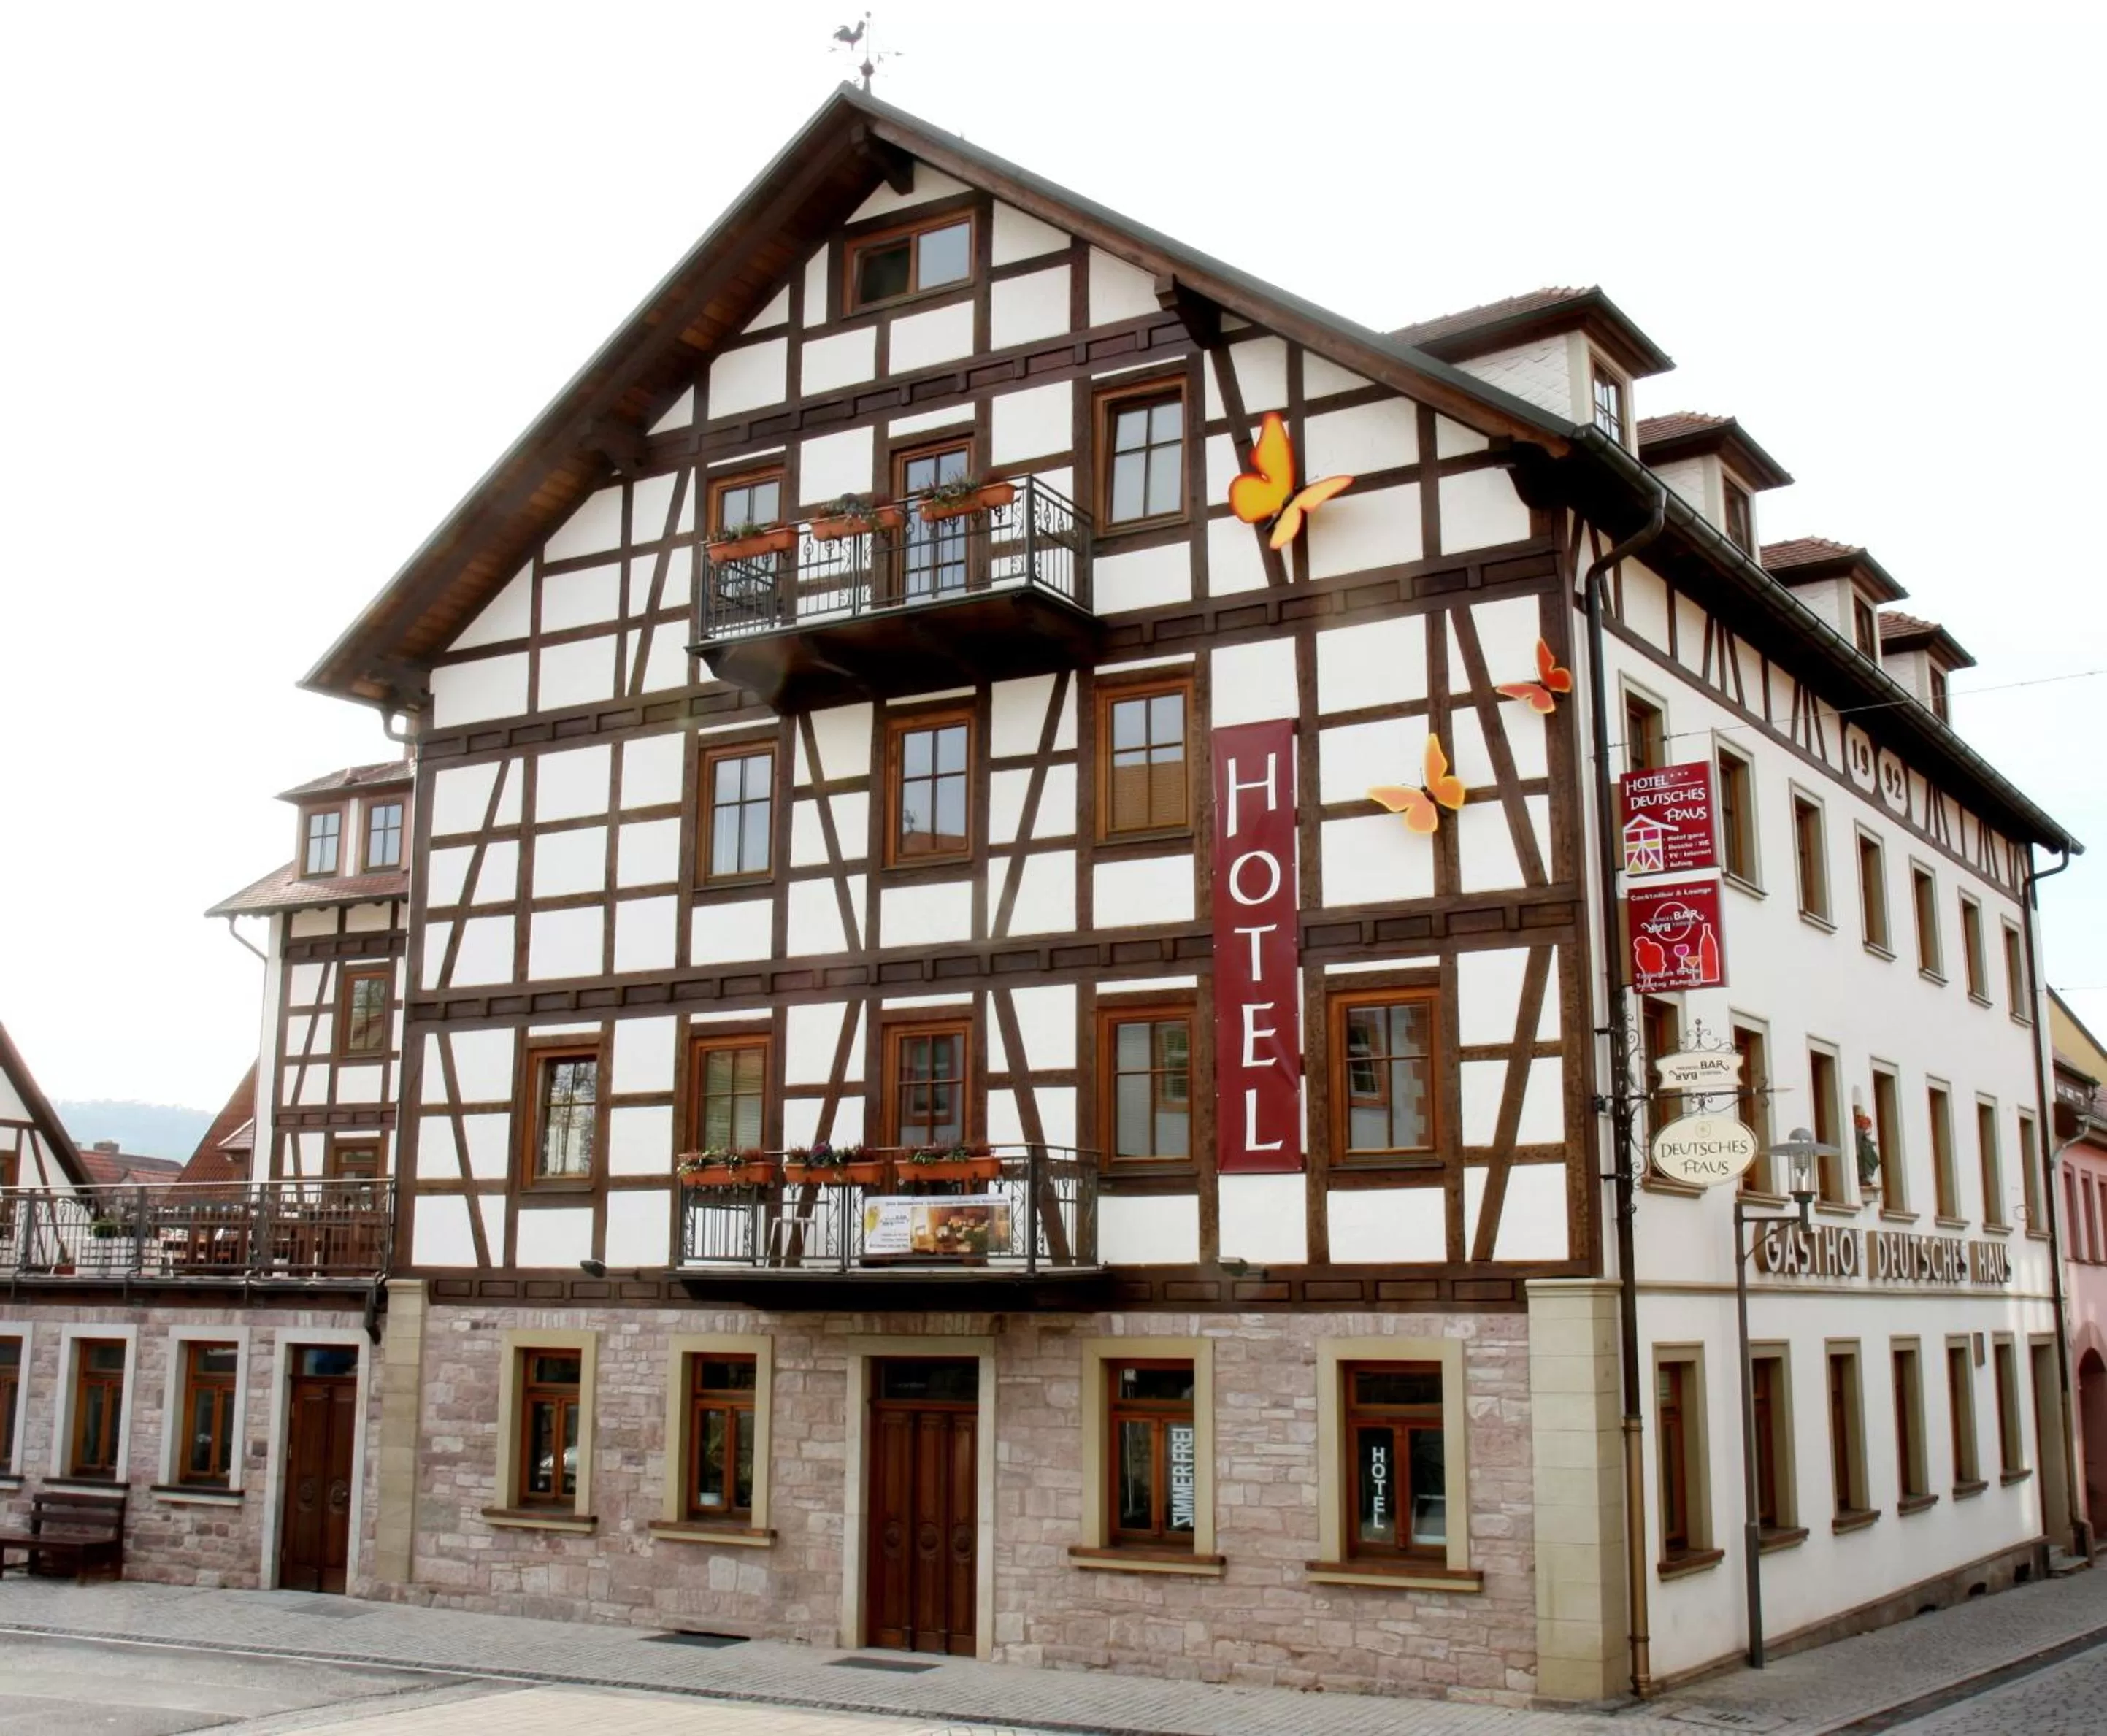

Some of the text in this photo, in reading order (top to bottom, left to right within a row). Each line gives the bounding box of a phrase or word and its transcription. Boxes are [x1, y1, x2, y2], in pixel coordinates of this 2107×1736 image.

[1626, 775, 1670, 796] HOTEL
[1630, 787, 1706, 810] DEUTSCHES
[1663, 806, 1708, 822] HAUS
[1673, 910, 1705, 921] BAR
[1227, 752, 1283, 1152] HOTEL
[1700, 1060, 1730, 1071] BAR
[1661, 1140, 1748, 1158] DEUTSCHES
[1681, 1158, 1729, 1175] HAUS
[1876, 1231, 1969, 1280] DEUTSCHES
[1976, 1243, 2013, 1283] HAUS
[1172, 1427, 1194, 1527] ZIMMER FREI
[1372, 1446, 1385, 1529] HOTEL
